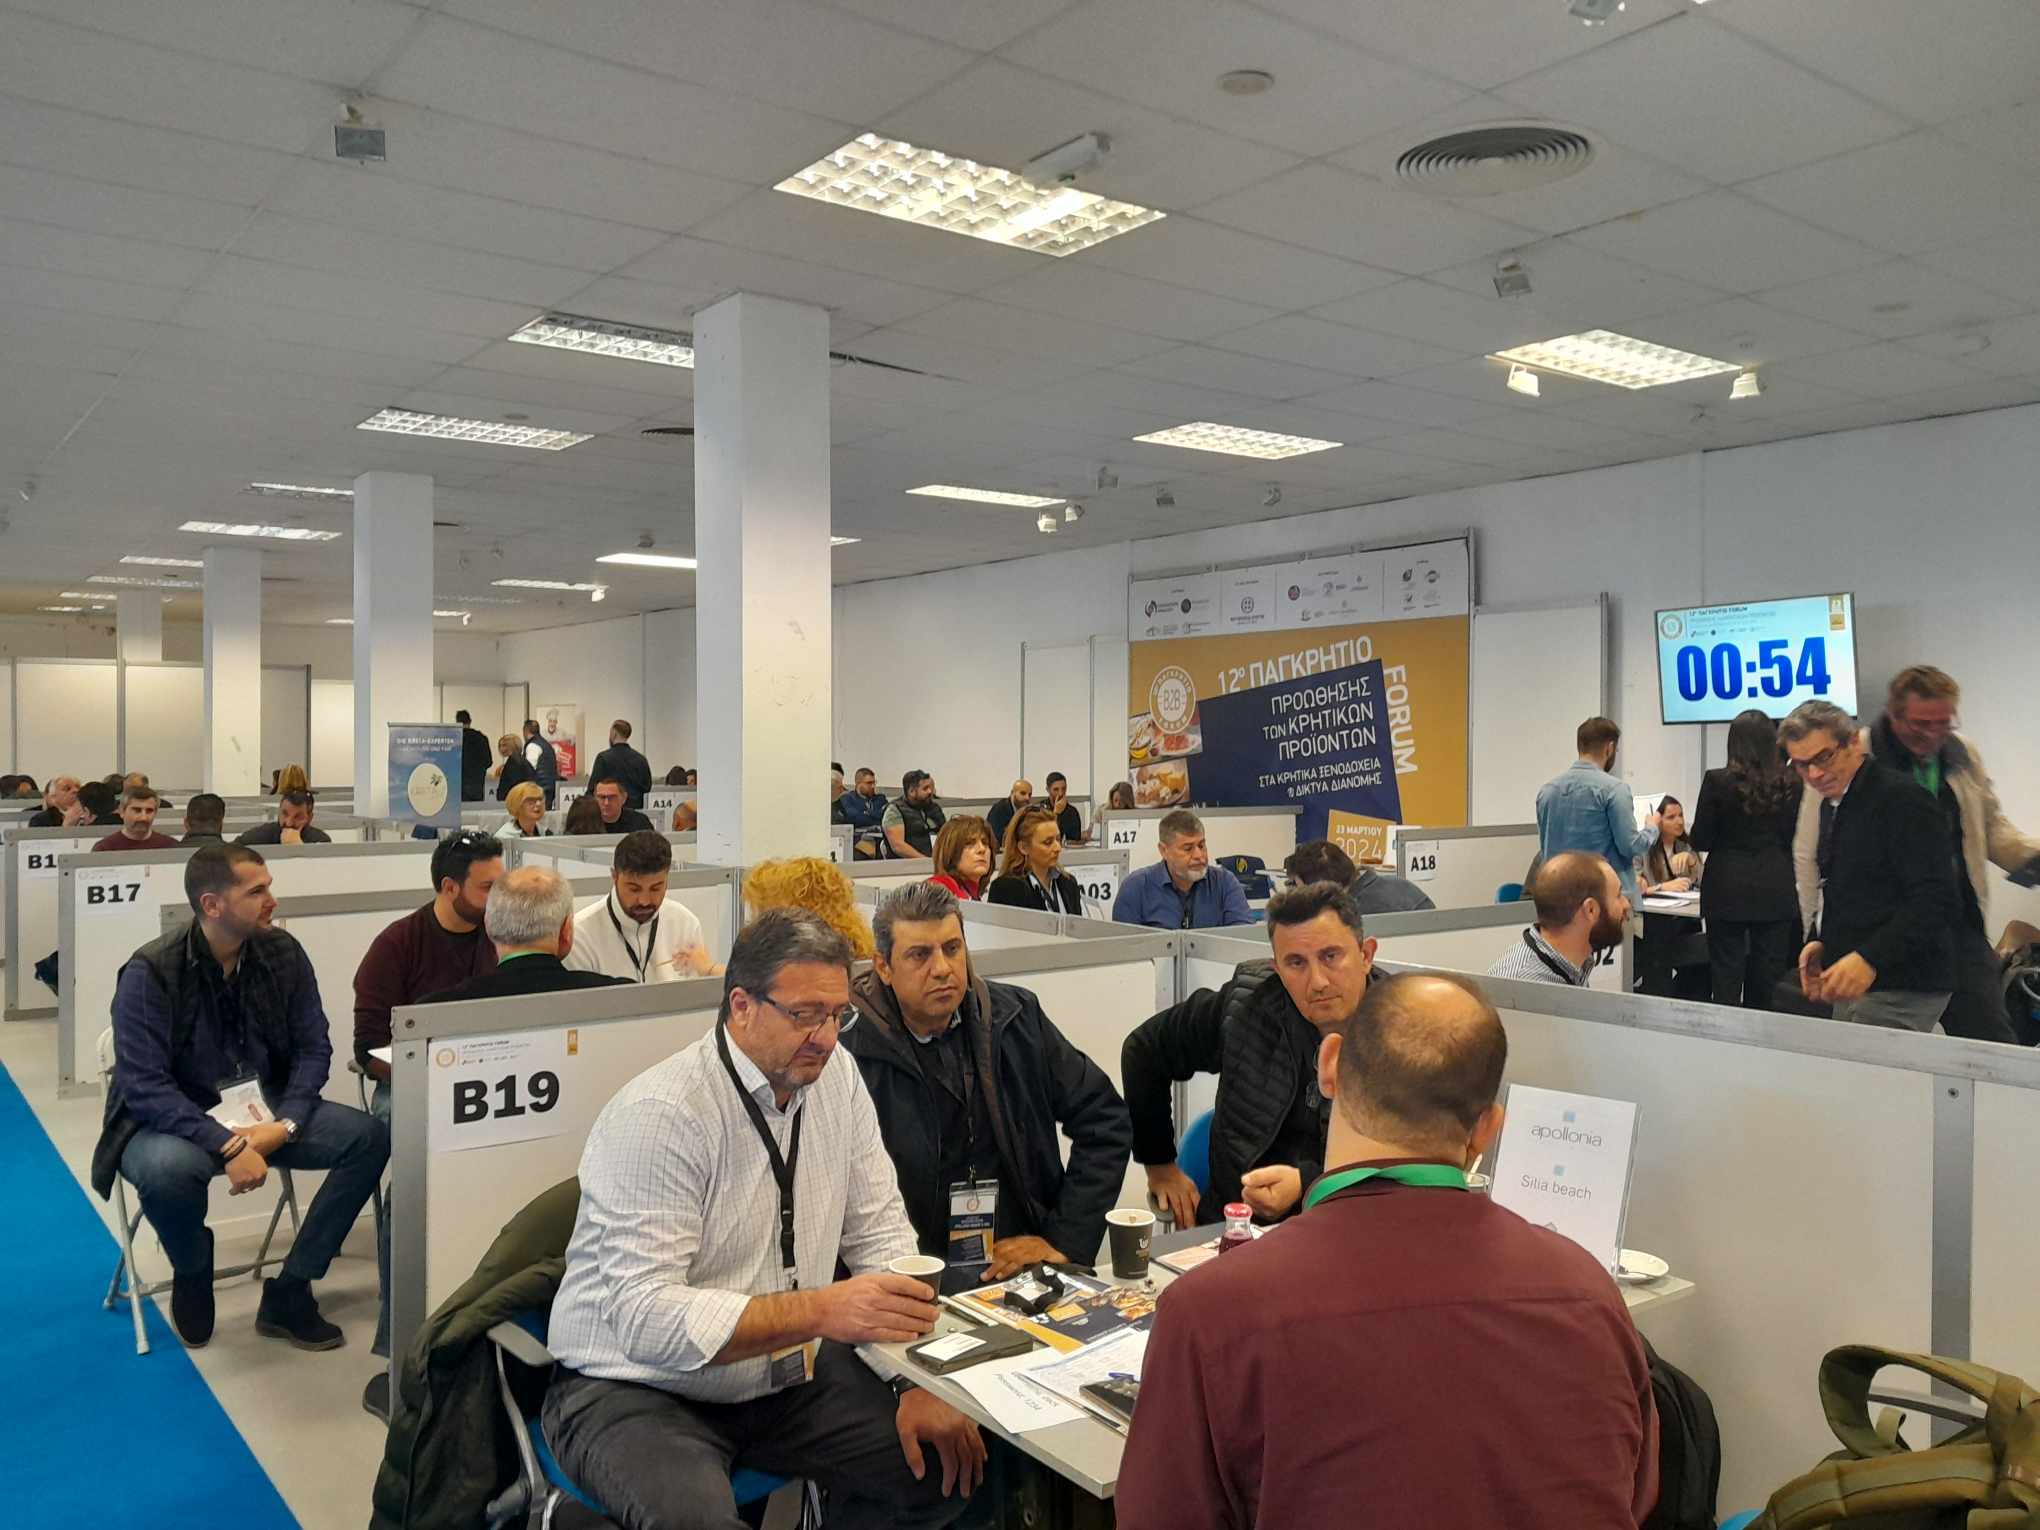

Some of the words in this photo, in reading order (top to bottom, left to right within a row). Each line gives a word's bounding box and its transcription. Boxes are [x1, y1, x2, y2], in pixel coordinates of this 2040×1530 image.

[1249, 635, 1374, 689] ΠΑΓΚΡΗΤΙΟ
[1677, 636, 1831, 701] 00:54
[1271, 676, 1372, 716] ΠΡΟΩΘΗΣΗΣ
[1263, 724, 1287, 741] ΤΩΝ
[1288, 701, 1374, 736] ΚΡΗΤΙΚΩΝ
[1384, 665, 1419, 775] FORUM
[1278, 725, 1377, 761] ΠΡΟΪΟΝΤΩΝ
[1259, 773, 1276, 788] ΣΤΑ
[1277, 768, 1317, 785] ΚΡΗΤΙΚΑ
[1318, 757, 1381, 779] ΞΕΝΟΔΟΧΕΙΑ
[1295, 780, 1329, 797] ΔΙΚΤΥΑ
[1331, 772, 1383, 792] ΔΙΑΝΟΜΗΣ
[653, 799, 673, 808] A14
[1113, 831, 1137, 844] A17
[1346, 825, 1383, 837] ΜΑΡΤΙΟΥ
[1335, 836, 1384, 861] 2024
[28, 854, 57, 869] B1
[1411, 855, 1436, 872] A18
[87, 883, 142, 904] B17
[453, 1069, 560, 1125] B19
[1530, 1124, 1603, 1148] apollonia
[1552, 1180, 1593, 1201] beach
